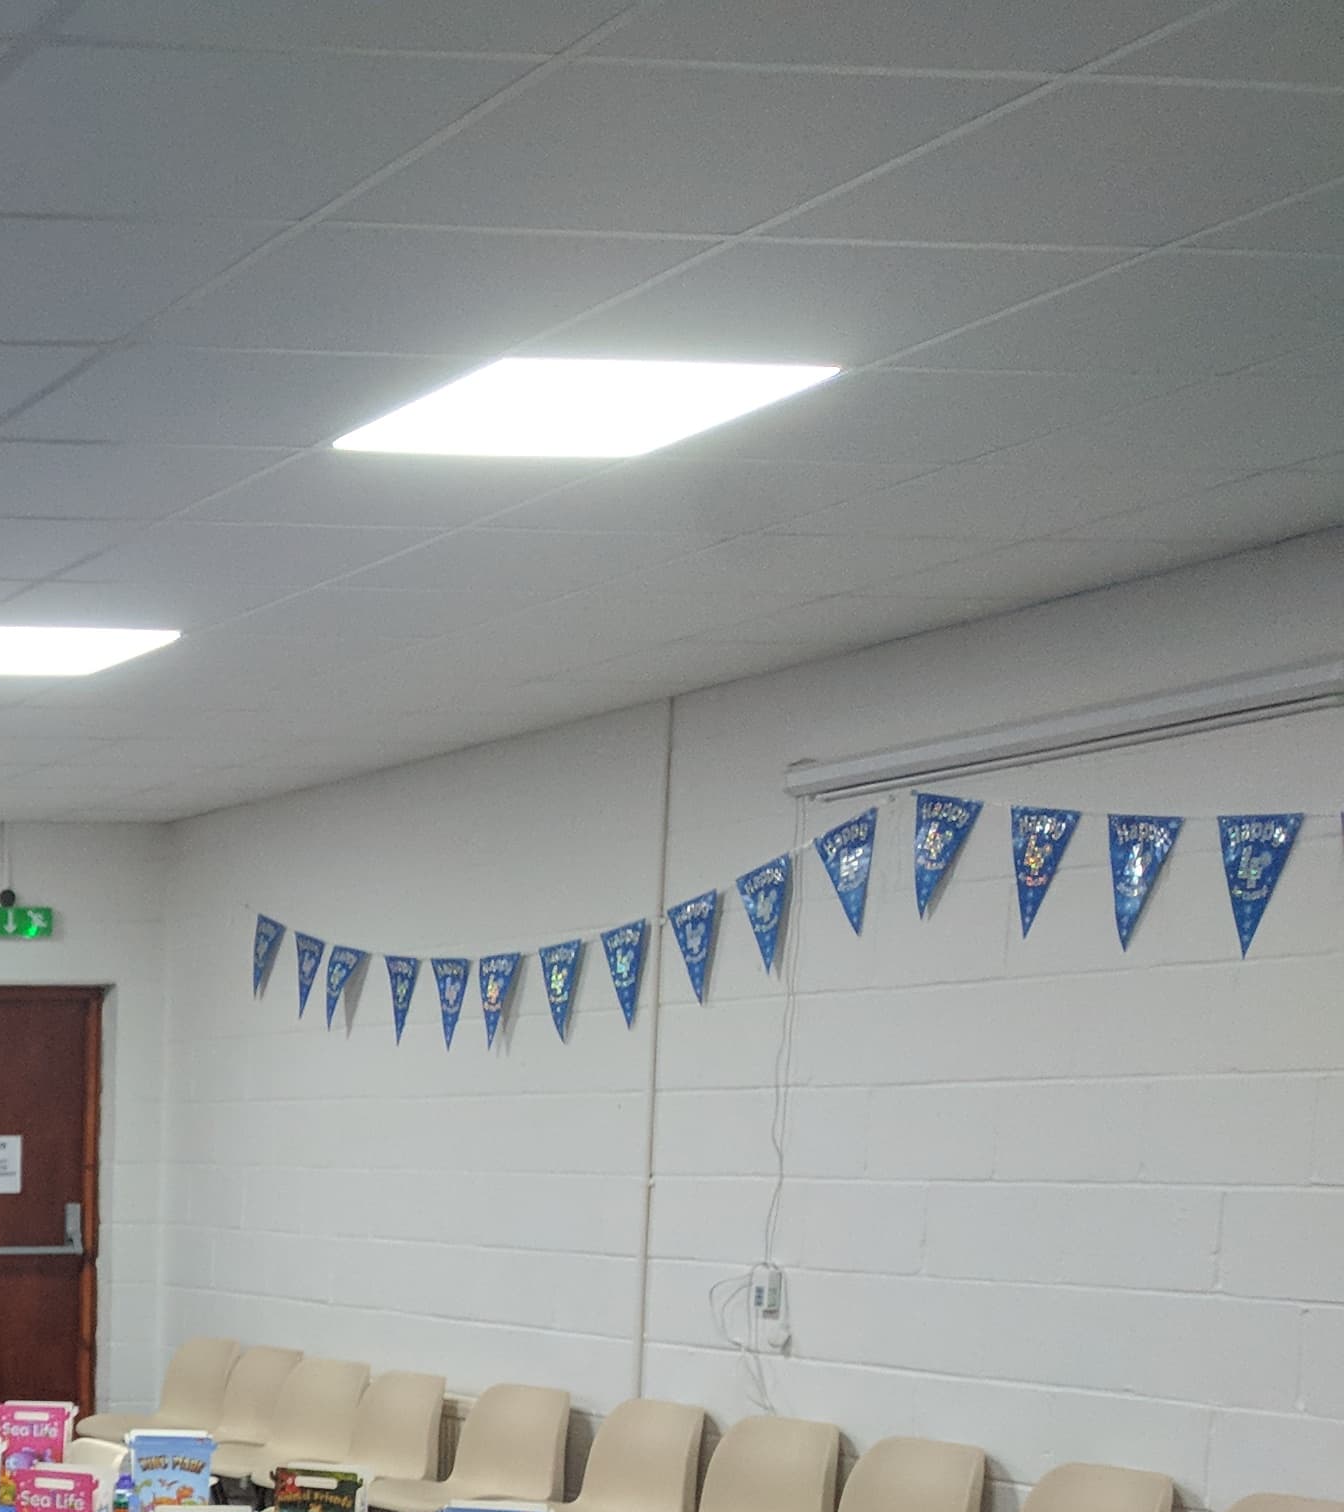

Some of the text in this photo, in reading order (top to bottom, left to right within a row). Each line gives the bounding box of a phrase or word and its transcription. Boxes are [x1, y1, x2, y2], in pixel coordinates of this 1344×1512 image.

[2, 1421, 58, 1438] Sea Life
[20, 1489, 86, 1512] Sea Life
